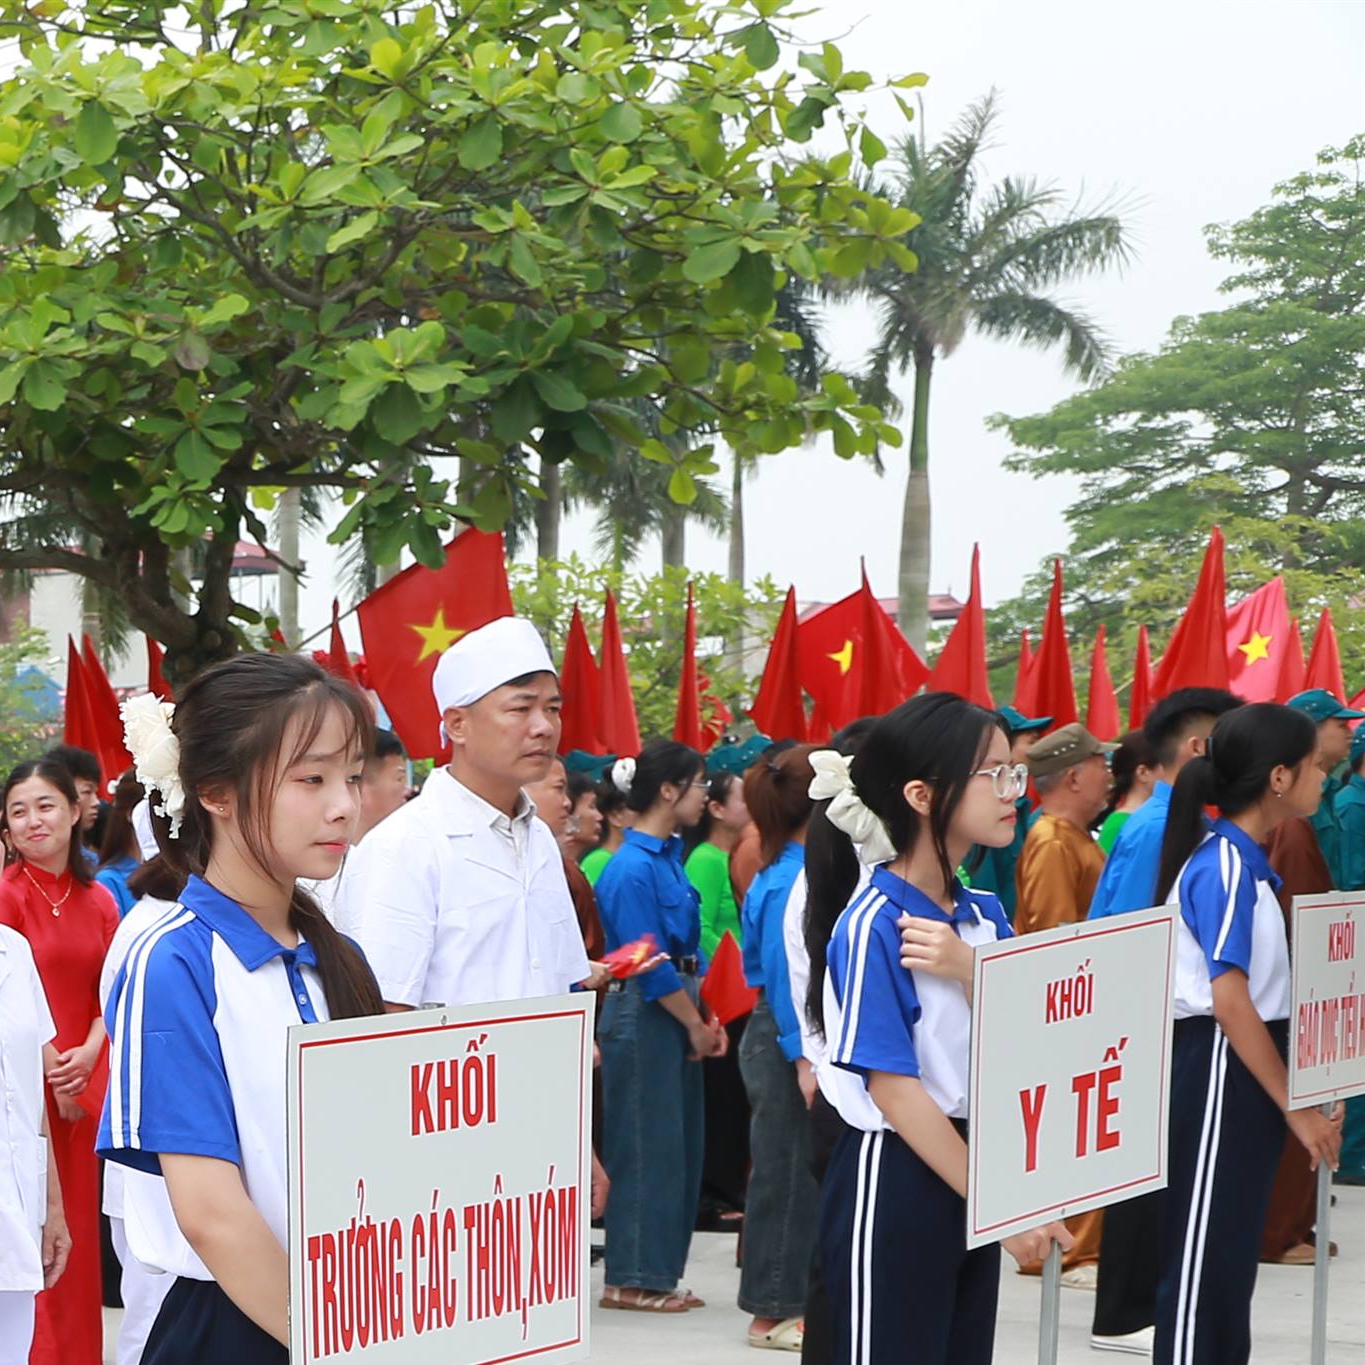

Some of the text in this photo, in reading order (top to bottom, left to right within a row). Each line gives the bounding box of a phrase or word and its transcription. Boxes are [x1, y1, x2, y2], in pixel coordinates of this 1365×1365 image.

[1045, 957, 1094, 1025] KHỐI
[410, 1032, 498, 1137] KHỐI
[1019, 1036, 1130, 1173] Y TẾ
[307, 1178, 404, 1359] TRƯỞNG
[411, 1189, 458, 1335] CÁC
